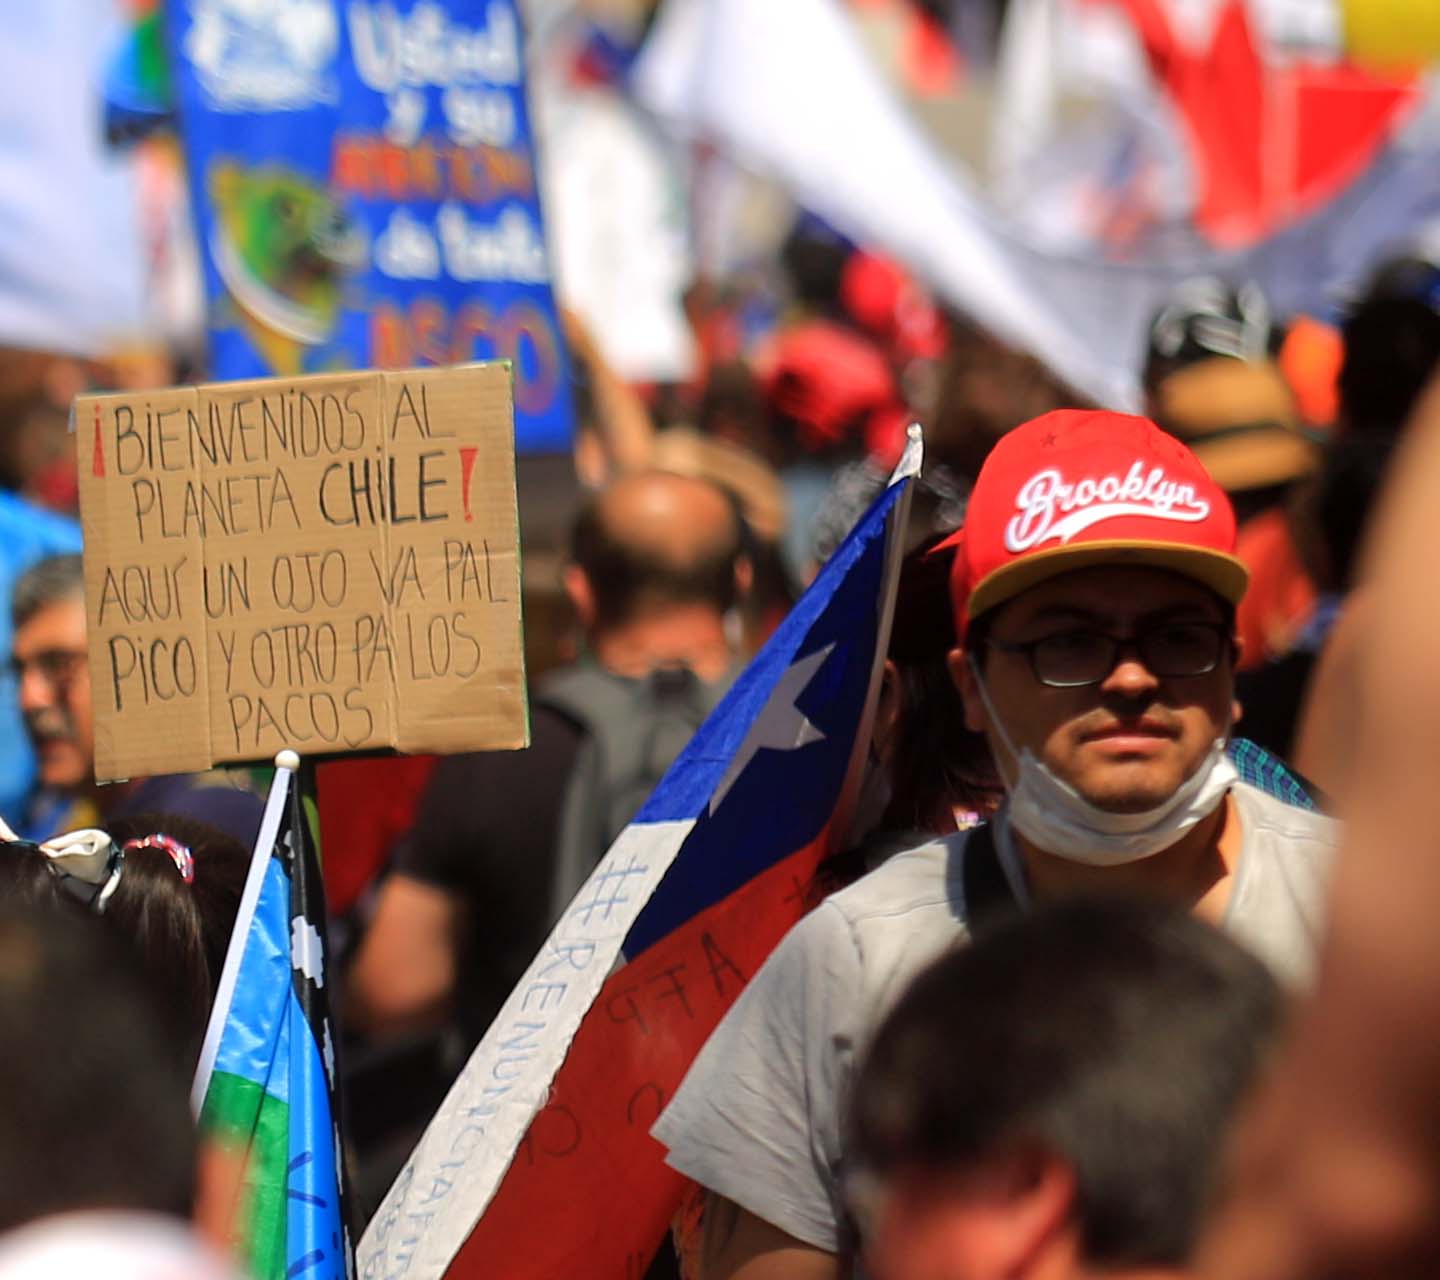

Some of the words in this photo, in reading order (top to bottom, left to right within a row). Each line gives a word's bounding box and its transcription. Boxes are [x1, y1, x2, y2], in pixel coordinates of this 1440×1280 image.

[391, 384, 456, 441] AL
[133, 468, 300, 543] PLANETA
[1004, 461, 1210, 553] Brooklyn
[204, 555, 251, 619] UN
[272, 550, 347, 614] OJO
[370, 545, 426, 610] VA
[444, 538, 509, 603] PAL
[220, 631, 236, 692] Y
[251, 623, 336, 691] OTRO
[409, 612, 481, 680] LOS
[231, 686, 373, 753] PACOS
